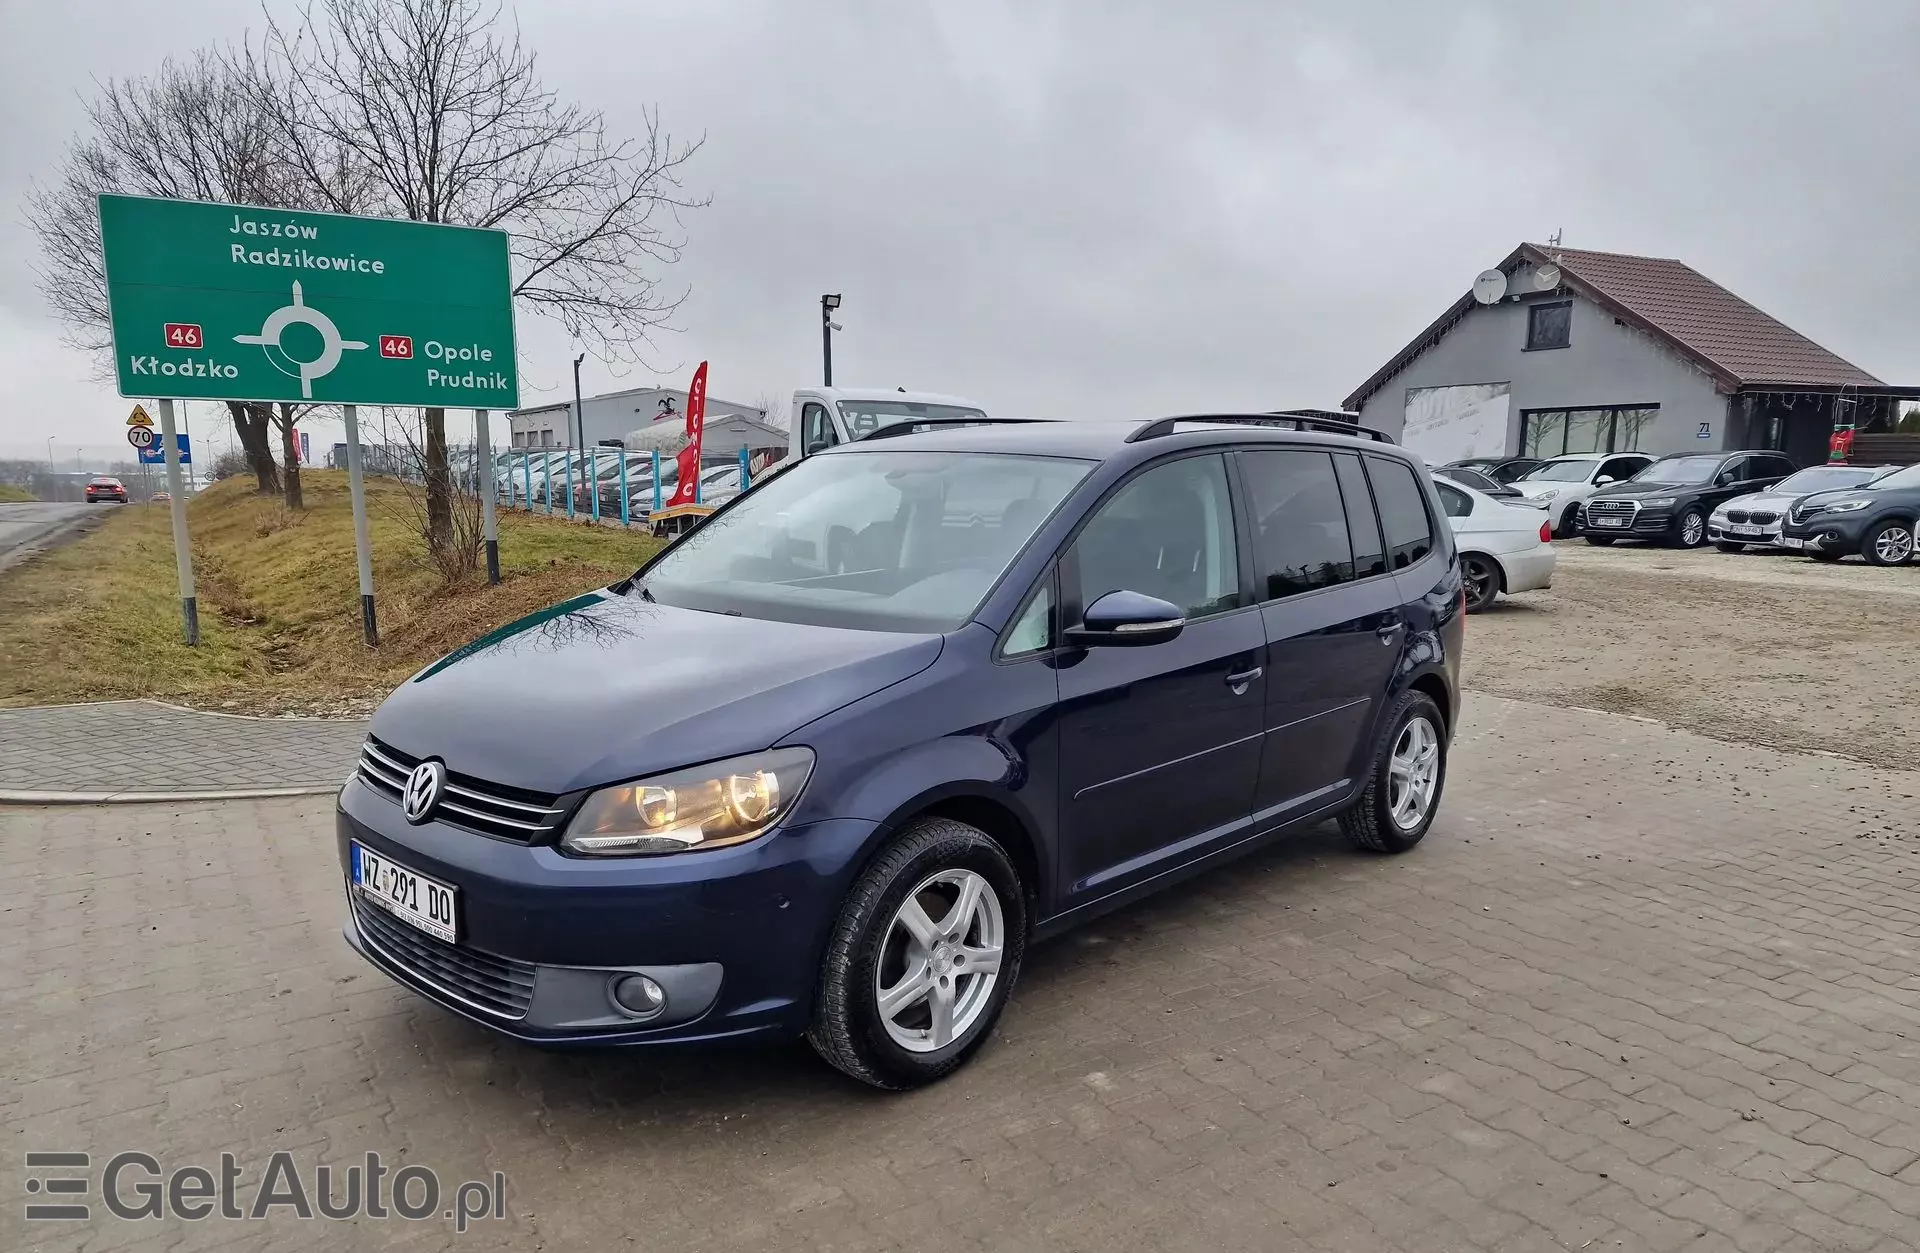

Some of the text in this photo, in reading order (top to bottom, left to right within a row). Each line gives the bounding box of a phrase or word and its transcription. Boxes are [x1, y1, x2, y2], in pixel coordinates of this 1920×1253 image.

[229, 214, 318, 240] Jaszów
[231, 243, 385, 274] Radzikowice
[171, 327, 197, 345] 46
[382, 339, 408, 356] 46
[424, 340, 492, 364] Opole
[130, 355, 239, 379] Kłodzko
[427, 369, 508, 390] Prudnik
[132, 431, 151, 443] 70
[390, 867, 419, 912] 291
[427, 884, 451, 925] DO
